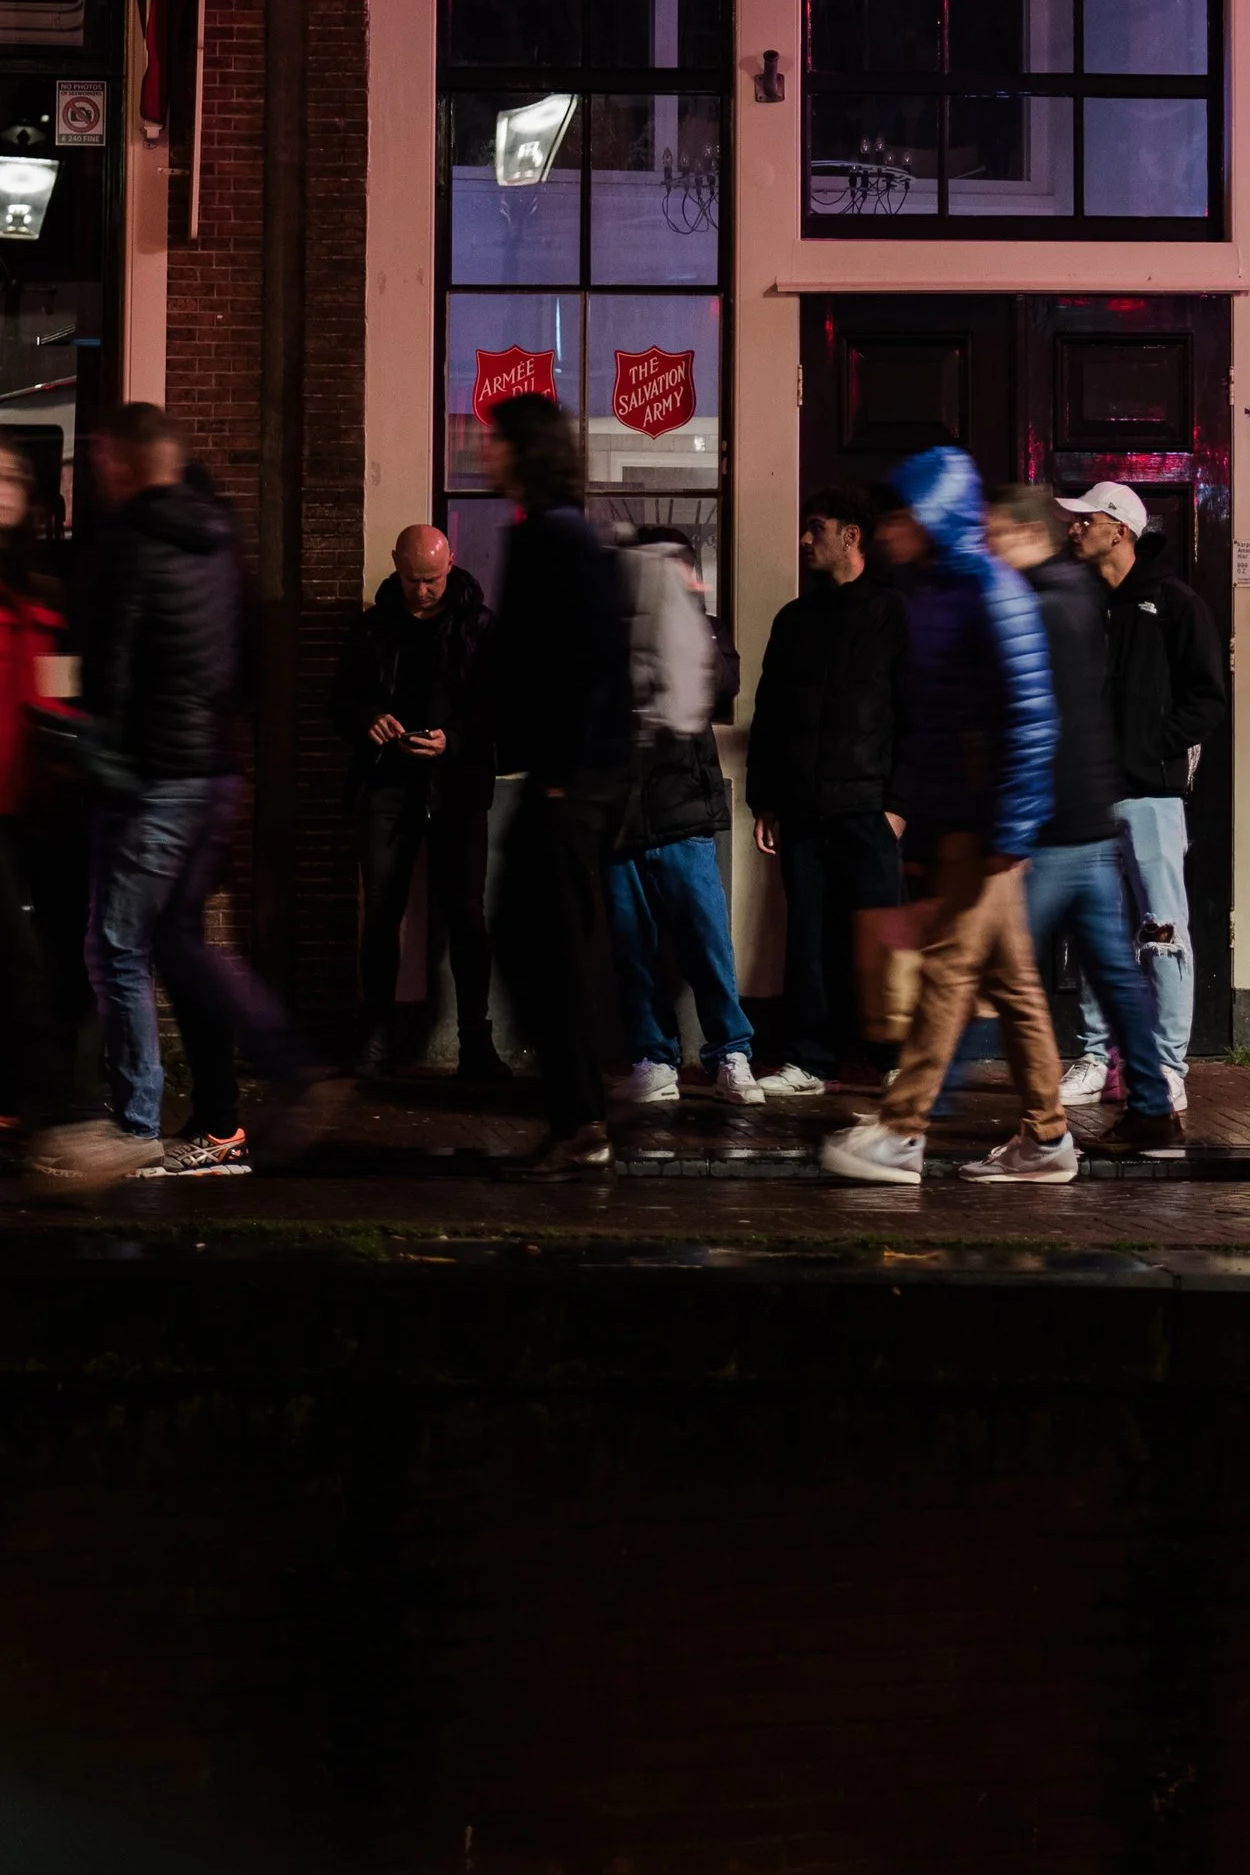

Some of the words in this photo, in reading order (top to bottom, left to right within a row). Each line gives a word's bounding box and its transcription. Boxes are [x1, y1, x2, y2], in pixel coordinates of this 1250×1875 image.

[478, 357, 535, 402] ARMÉE
[511, 377, 536, 399] DU
[618, 361, 686, 416] SALVATION
[629, 356, 660, 385] THE
[642, 386, 684, 428] ARMY
